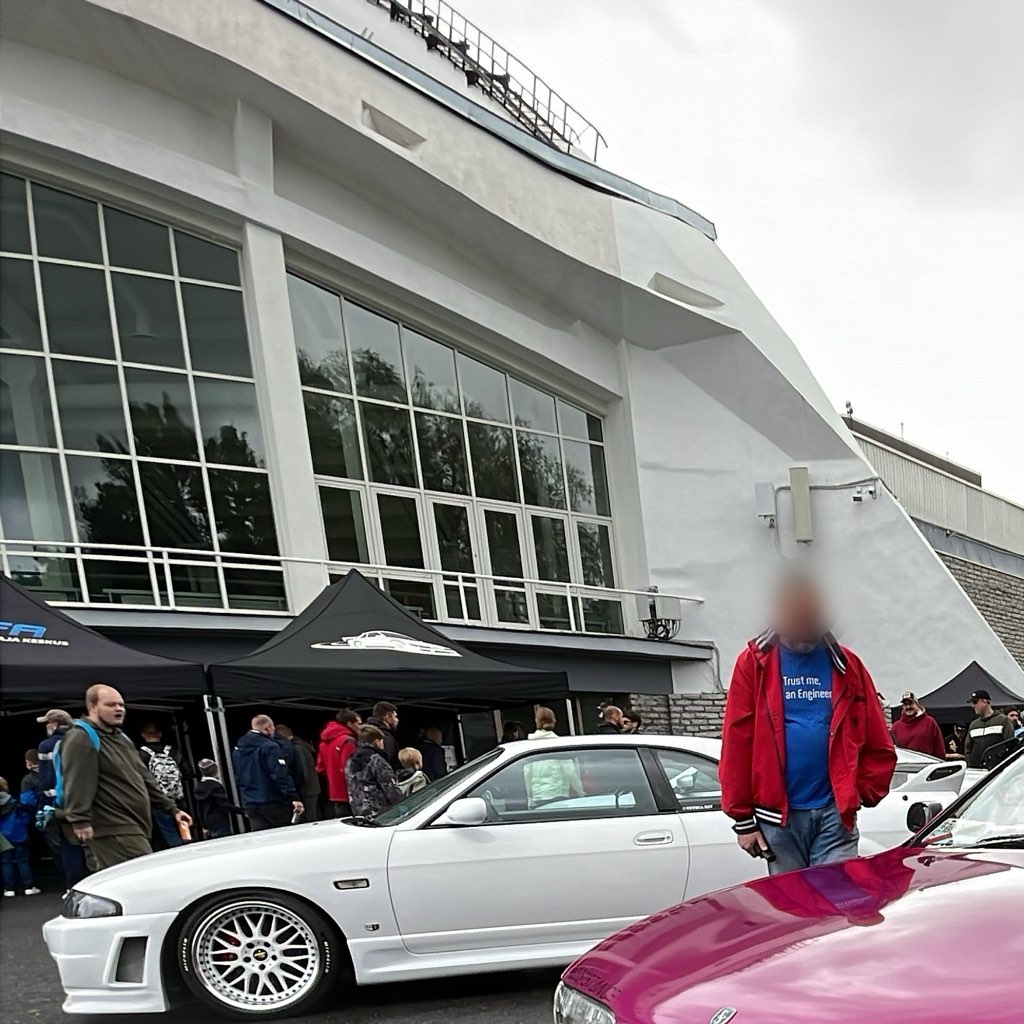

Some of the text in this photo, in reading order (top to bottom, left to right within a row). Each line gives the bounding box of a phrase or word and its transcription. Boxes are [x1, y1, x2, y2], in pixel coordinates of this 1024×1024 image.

[22, 638, 69, 646] KESKUS
[783, 676, 821, 686] Trust me,
[785, 691, 796, 699] an
